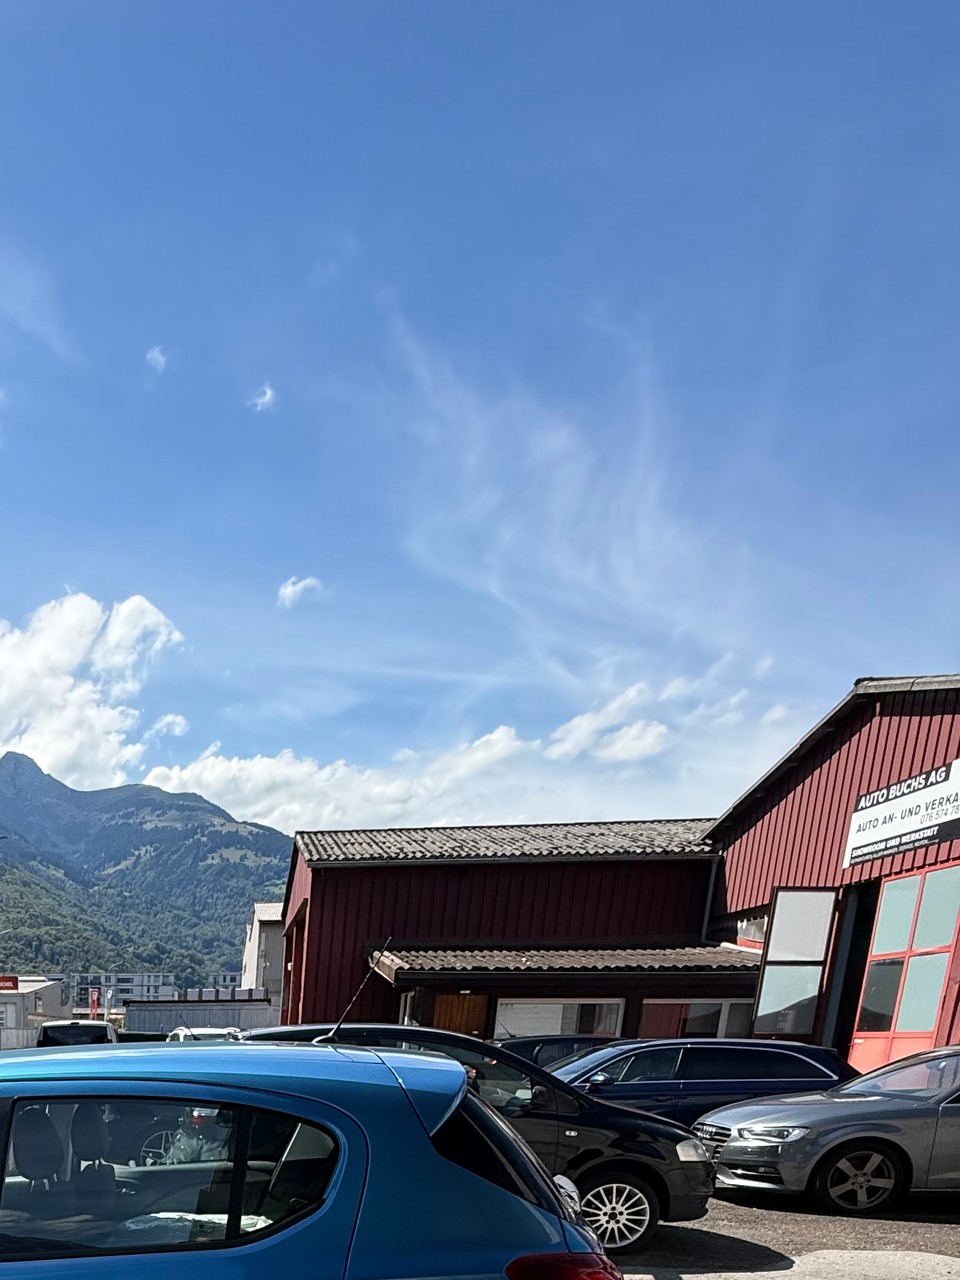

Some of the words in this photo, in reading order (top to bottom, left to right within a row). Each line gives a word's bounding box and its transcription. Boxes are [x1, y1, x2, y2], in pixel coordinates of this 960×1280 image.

[858, 789, 887, 810] AUTO
[888, 775, 927, 802] BUCHS
[927, 767, 947, 785] AG
[856, 818, 879, 834] AUTO
[881, 813, 898, 826] AN-
[901, 804, 921, 820] UND
[925, 792, 960, 812] VERKA
[920, 812, 934, 825] 076
[901, 827, 939, 844] WERKSTATT
